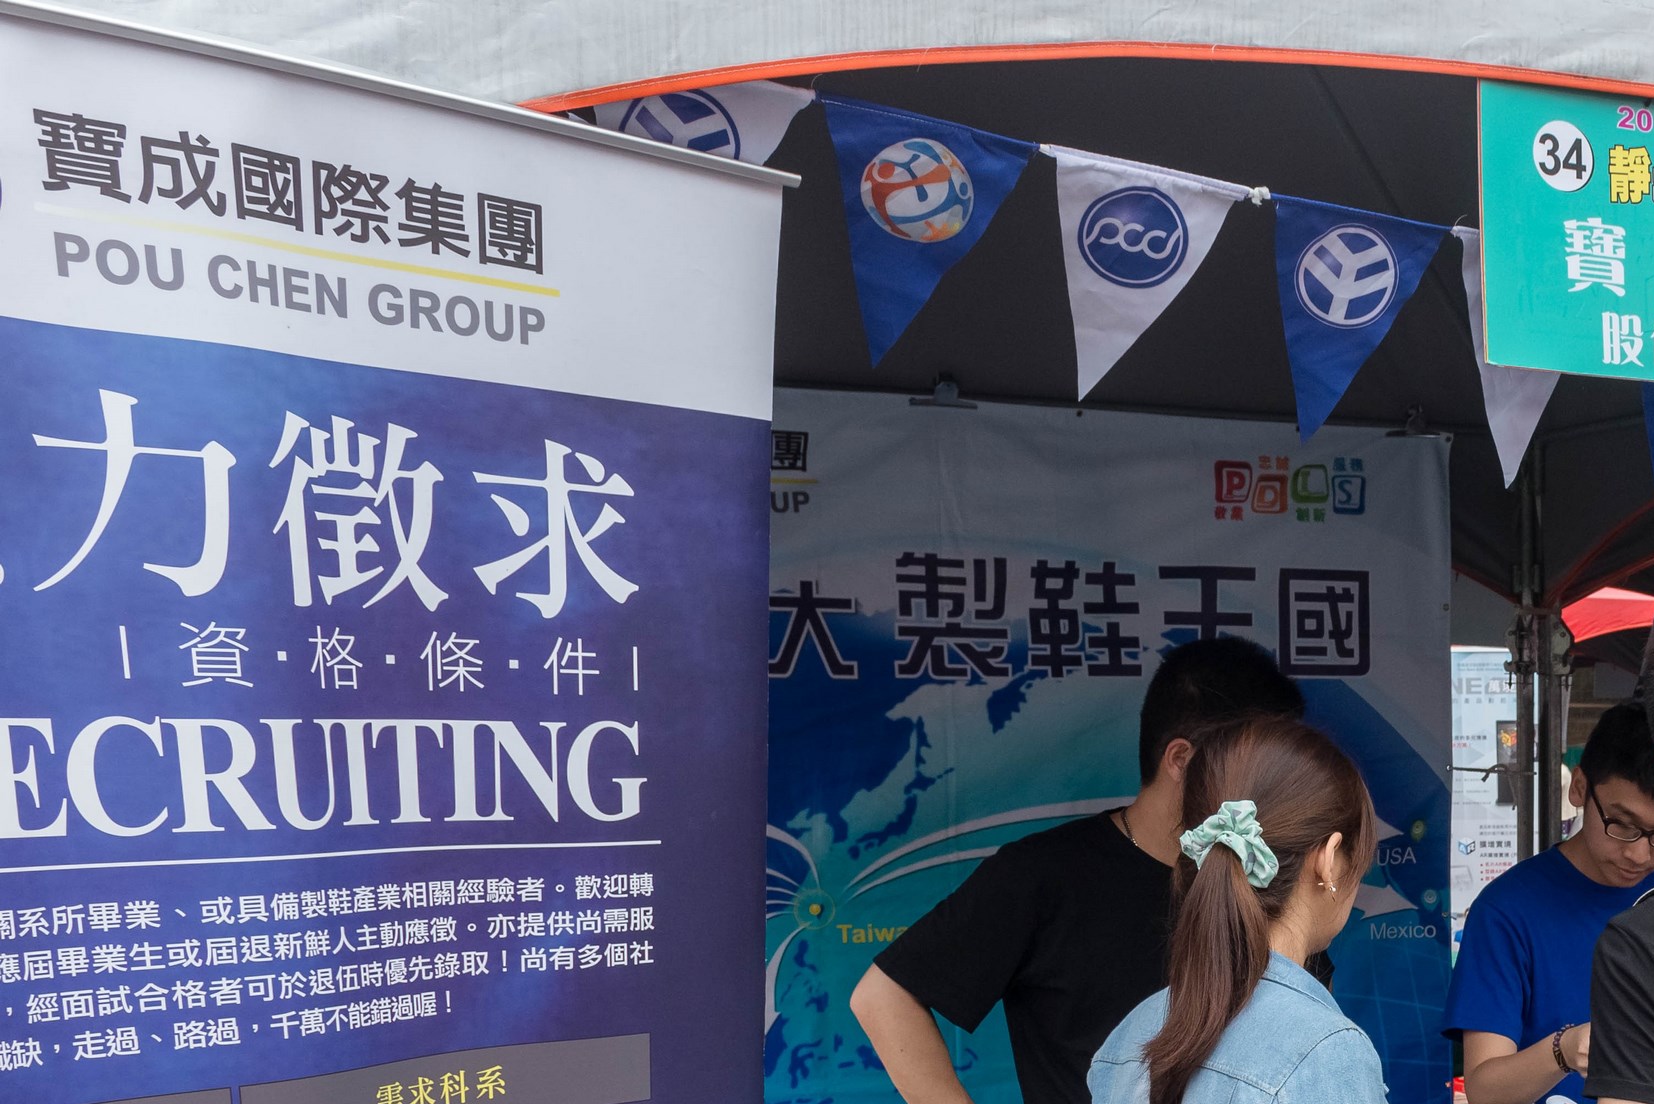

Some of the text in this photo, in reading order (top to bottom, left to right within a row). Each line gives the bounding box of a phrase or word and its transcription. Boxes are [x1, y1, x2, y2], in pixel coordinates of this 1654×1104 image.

[32, 108, 545, 276] 寶成國際集團
[1539, 133, 1587, 180] 34
[53, 231, 547, 346] POU CHEN GROUP
[31, 388, 640, 618] 力徵求
[0, 716, 648, 839] ECRUITING
[1376, 846, 1416, 866] USA
[1370, 921, 1437, 940] Mexico
